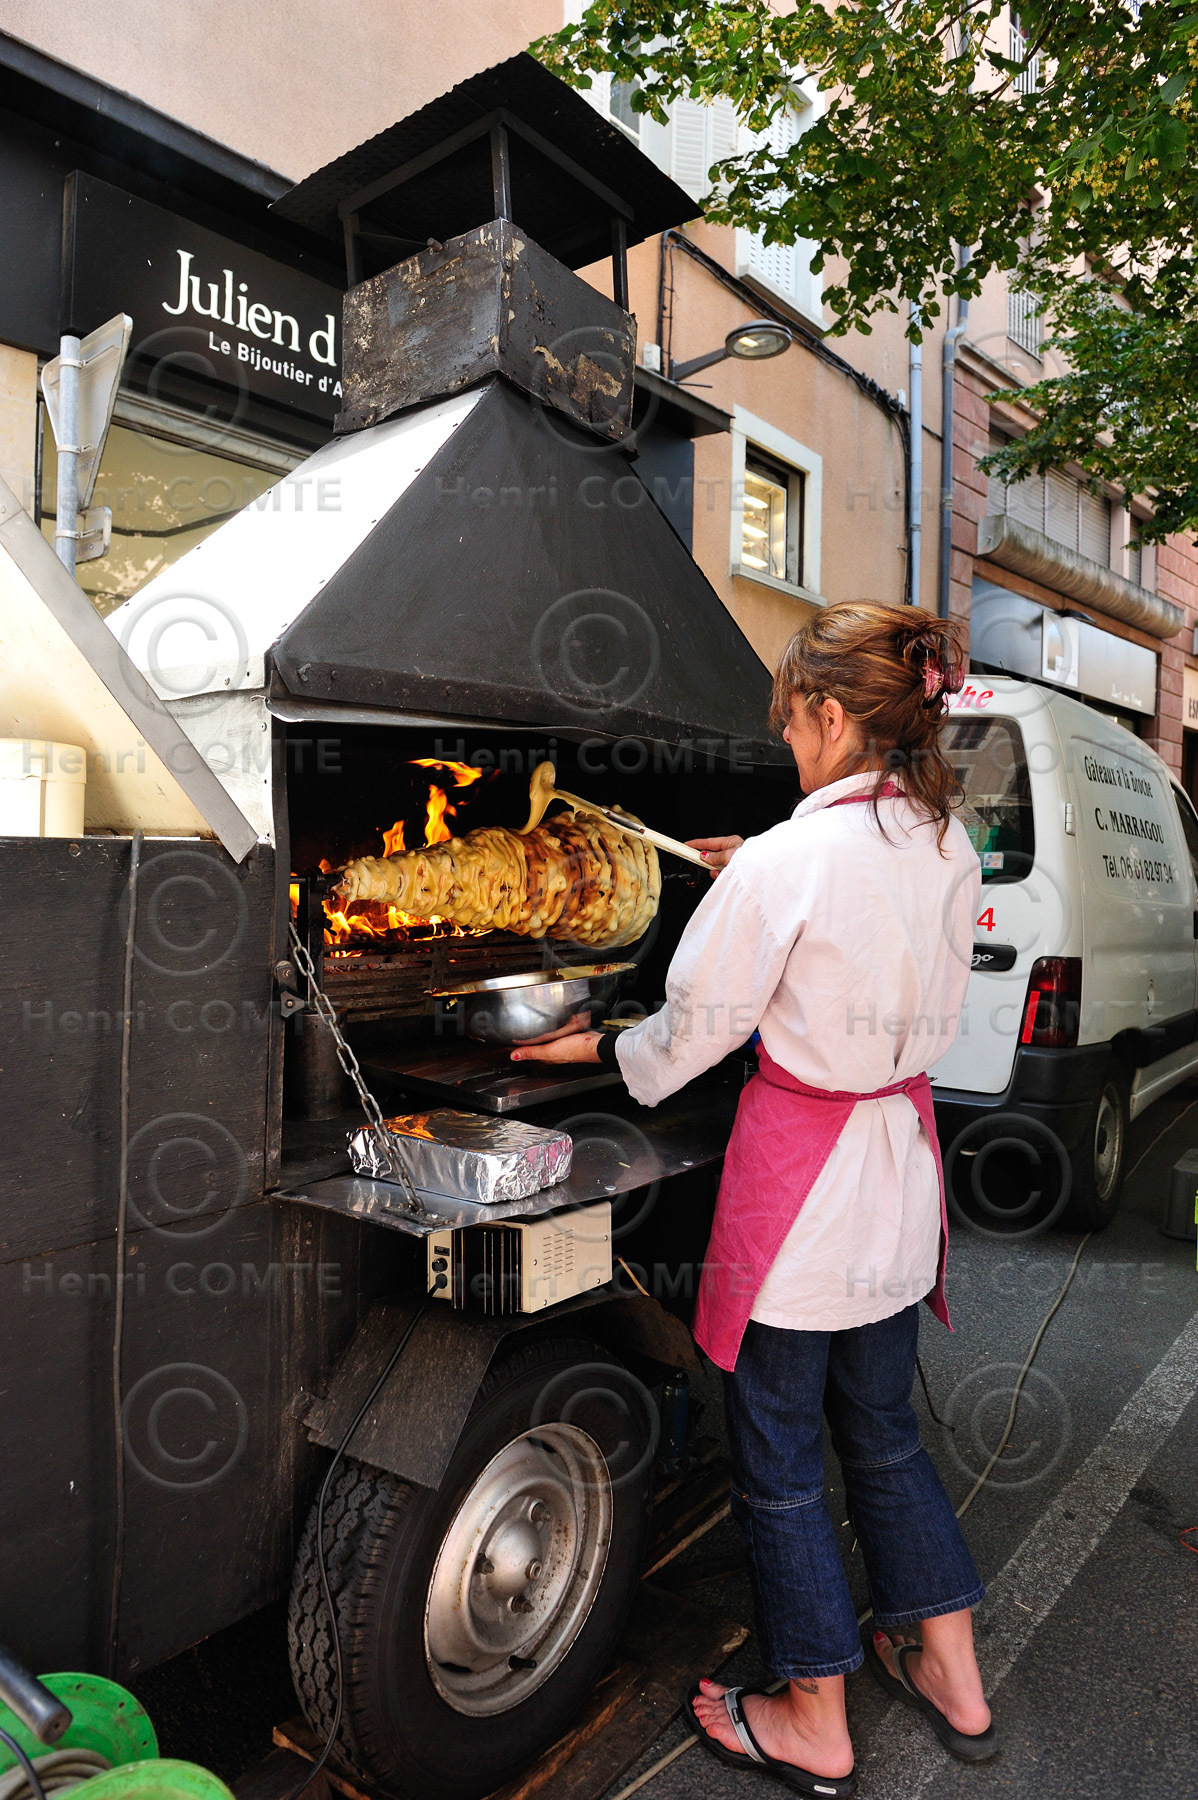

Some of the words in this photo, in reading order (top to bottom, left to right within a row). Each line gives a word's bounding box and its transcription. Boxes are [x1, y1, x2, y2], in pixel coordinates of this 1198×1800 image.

[162, 249, 301, 352] Julien
[208, 331, 231, 355] Le
[237, 342, 313, 387] Bijoutier
[1095, 807, 1108, 830] C.
[1109, 810, 1164, 844] MARRAGOU
[1102, 855, 1120, 878] Tél.
[976, 907, 996, 931] 4
